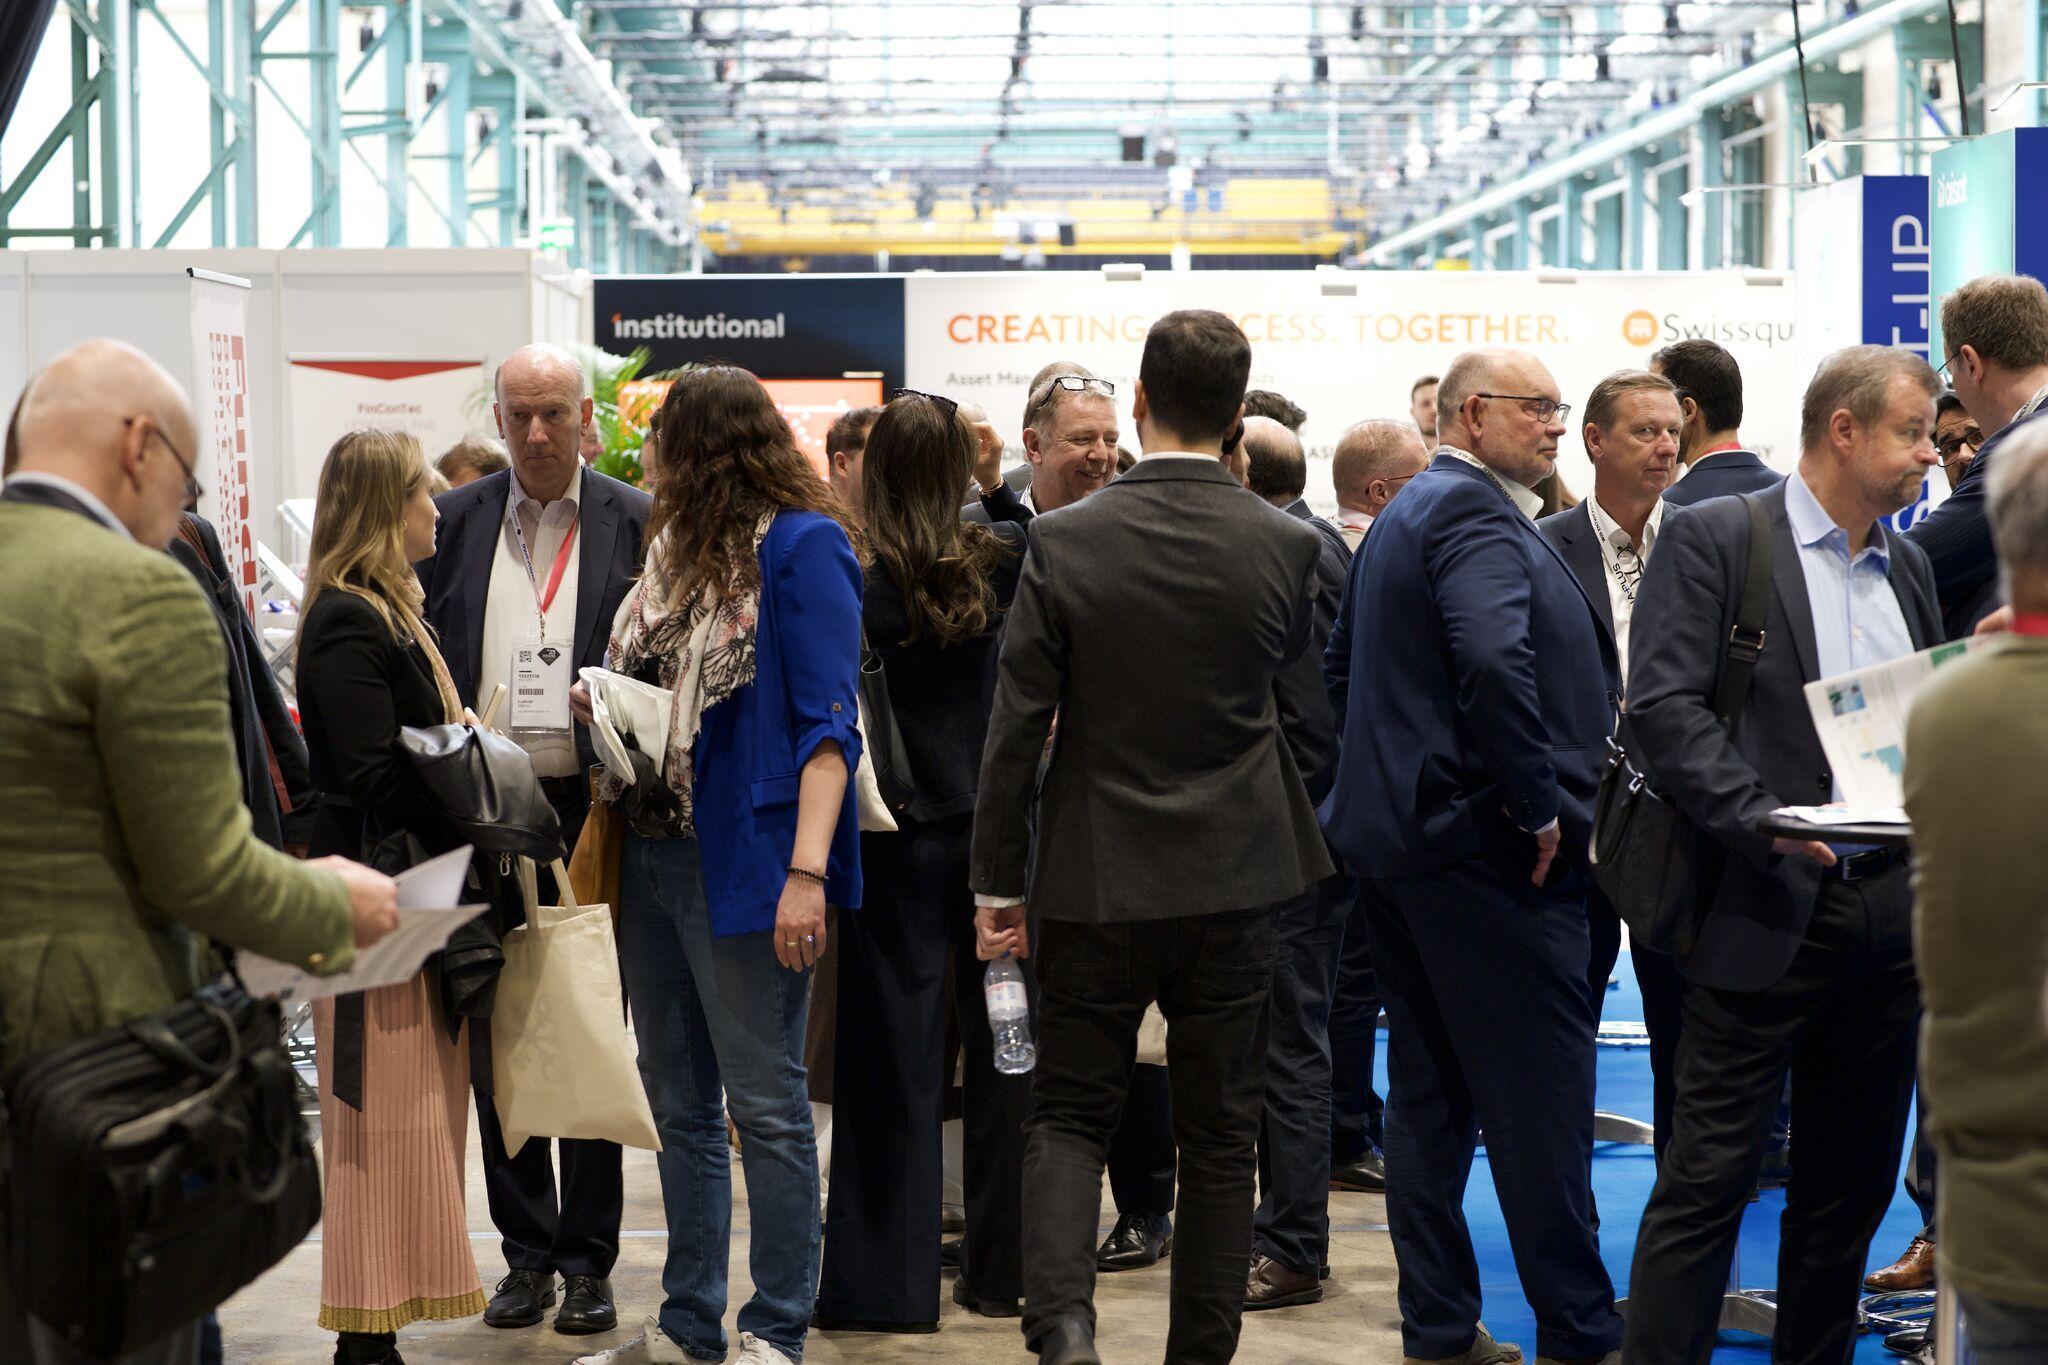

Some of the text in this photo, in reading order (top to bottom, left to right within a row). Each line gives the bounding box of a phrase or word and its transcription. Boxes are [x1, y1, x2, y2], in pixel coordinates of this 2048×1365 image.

[612, 312, 785, 338] institutional
[946, 313, 1146, 344] CREATING
[1350, 313, 1570, 344] TOGETHER.
